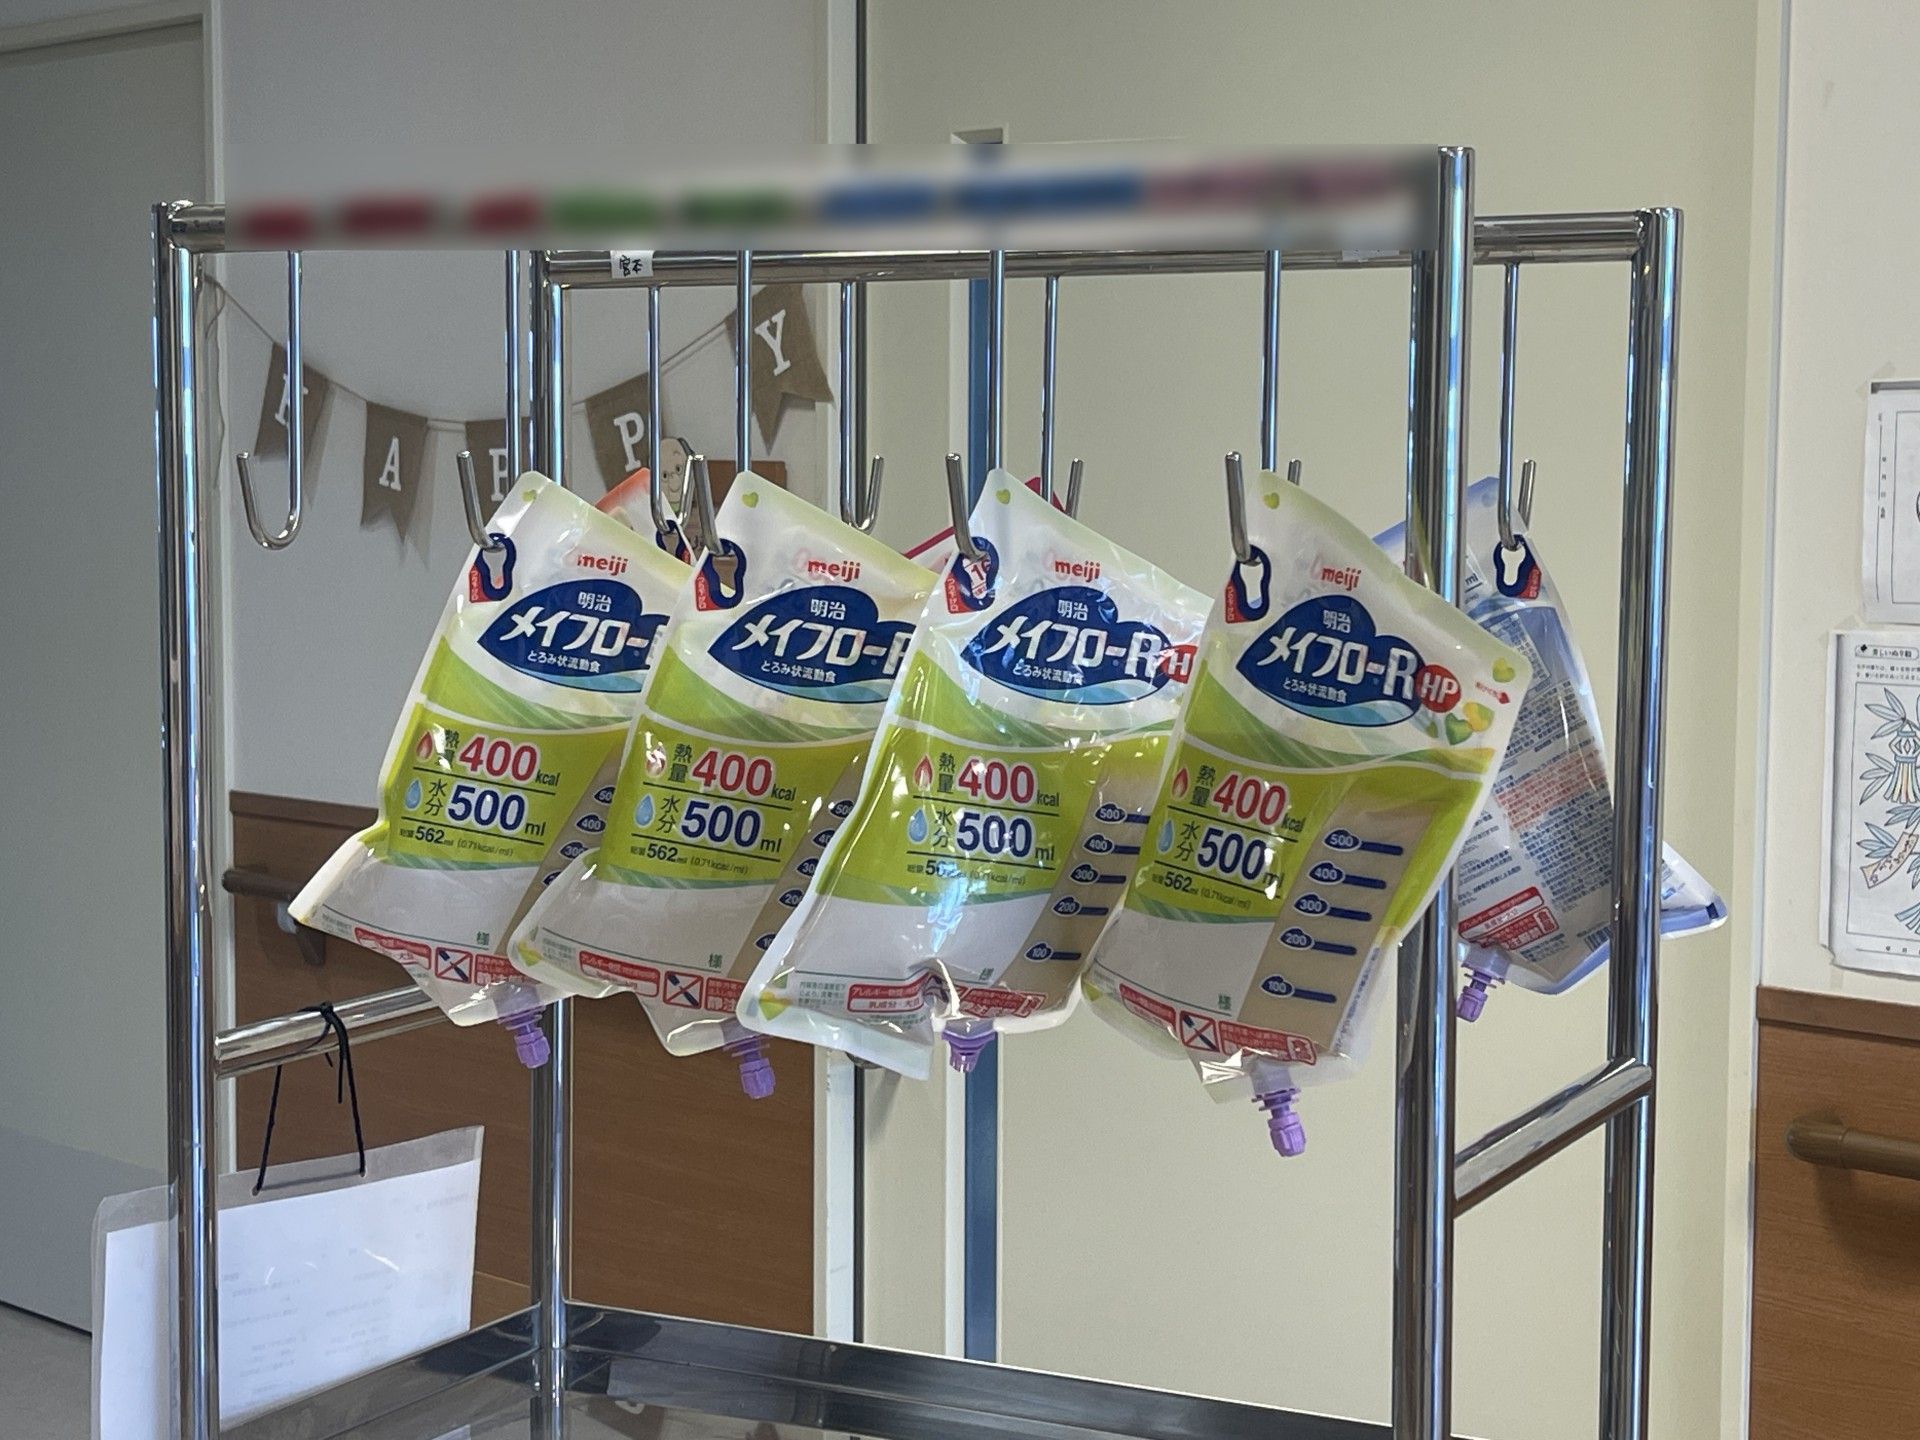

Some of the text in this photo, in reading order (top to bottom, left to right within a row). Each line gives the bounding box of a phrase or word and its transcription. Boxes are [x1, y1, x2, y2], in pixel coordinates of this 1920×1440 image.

[613, 412, 646, 471] P
[755, 309, 792, 376] Y
[577, 554, 628, 576] meiji
[808, 559, 861, 582] meiji
[1055, 559, 1101, 582] meiji
[1321, 564, 1362, 591] meiji
[578, 592, 612, 613] 明治
[810, 599, 846, 621] 明治
[1057, 600, 1089, 621] 明治
[1322, 610, 1351, 633] 明治
[527, 650, 601, 674] とろみ状流動食
[761, 660, 837, 685] とろみ状流動食
[1168, 650, 1193, 677] H
[1256, 627, 1419, 700] メイフローR
[1421, 670, 1459, 706] HP
[1283, 675, 1348, 704] とろみ状流動食
[667, 744, 693, 783] 熱量
[938, 753, 956, 794] 熱量
[599, 792, 612, 801] 50
[1192, 764, 1216, 808] 熱量
[424, 779, 448, 816] 水分
[656, 795, 681, 834] 水分
[836, 804, 853, 815] 50
[1099, 808, 1121, 820] 500
[581, 819, 601, 830] 400
[932, 806, 951, 848] 水分
[1089, 840, 1109, 851] 400
[1174, 820, 1200, 862] 水分
[1330, 833, 1353, 846] 500
[803, 863, 815, 874] 30
[1074, 868, 1093, 880] 300
[1314, 868, 1336, 880] 400
[785, 894, 801, 905] 20
[1057, 901, 1076, 913] 200
[1300, 899, 1322, 912] 300
[1286, 933, 1307, 946] 200
[709, 953, 722, 969] 様
[1030, 946, 1048, 960] 100
[1267, 980, 1286, 993] 100
